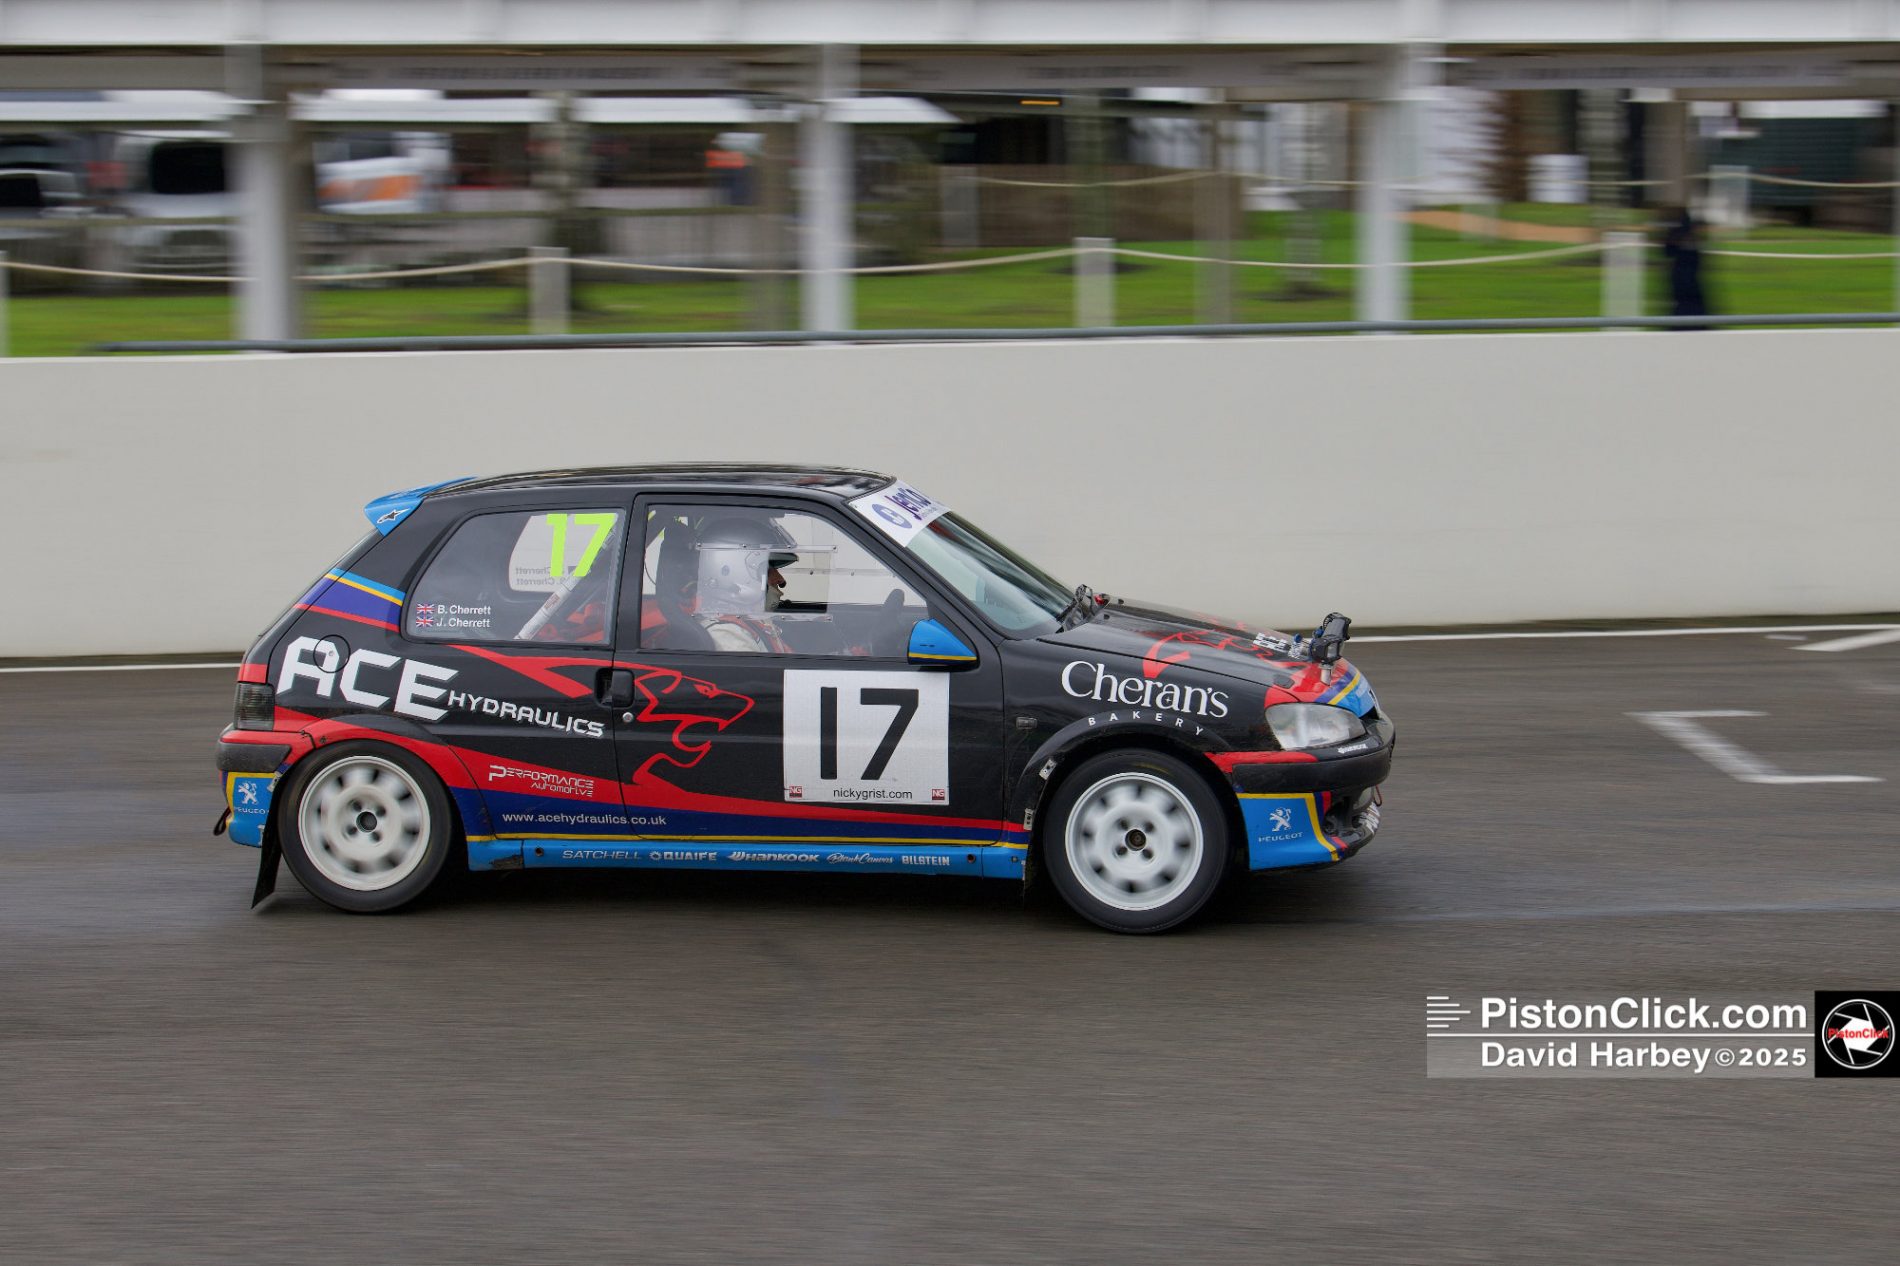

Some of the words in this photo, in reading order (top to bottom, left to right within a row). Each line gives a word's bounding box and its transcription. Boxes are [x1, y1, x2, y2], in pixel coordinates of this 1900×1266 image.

[545, 513, 616, 577] 17
[437, 605, 448, 614] B.
[449, 605, 491, 615] Cherrett
[436, 618, 447, 627] J.
[448, 618, 490, 628] Cherrett
[276, 636, 459, 721] ACE
[447, 690, 605, 738] HYDRAULICS
[1061, 660, 1229, 718] Cheran's
[1088, 710, 1204, 736] BAKERY
[820, 687, 919, 780] 17
[833, 787, 913, 800] nickygrist.com
[502, 813, 667, 826] www.acehydraulics.co.uk
[1258, 831, 1304, 843] PEUGEOT
[562, 850, 642, 860] SATCHELL
[663, 851, 718, 861] QUAIFE
[902, 855, 950, 866] BILSTEIN
